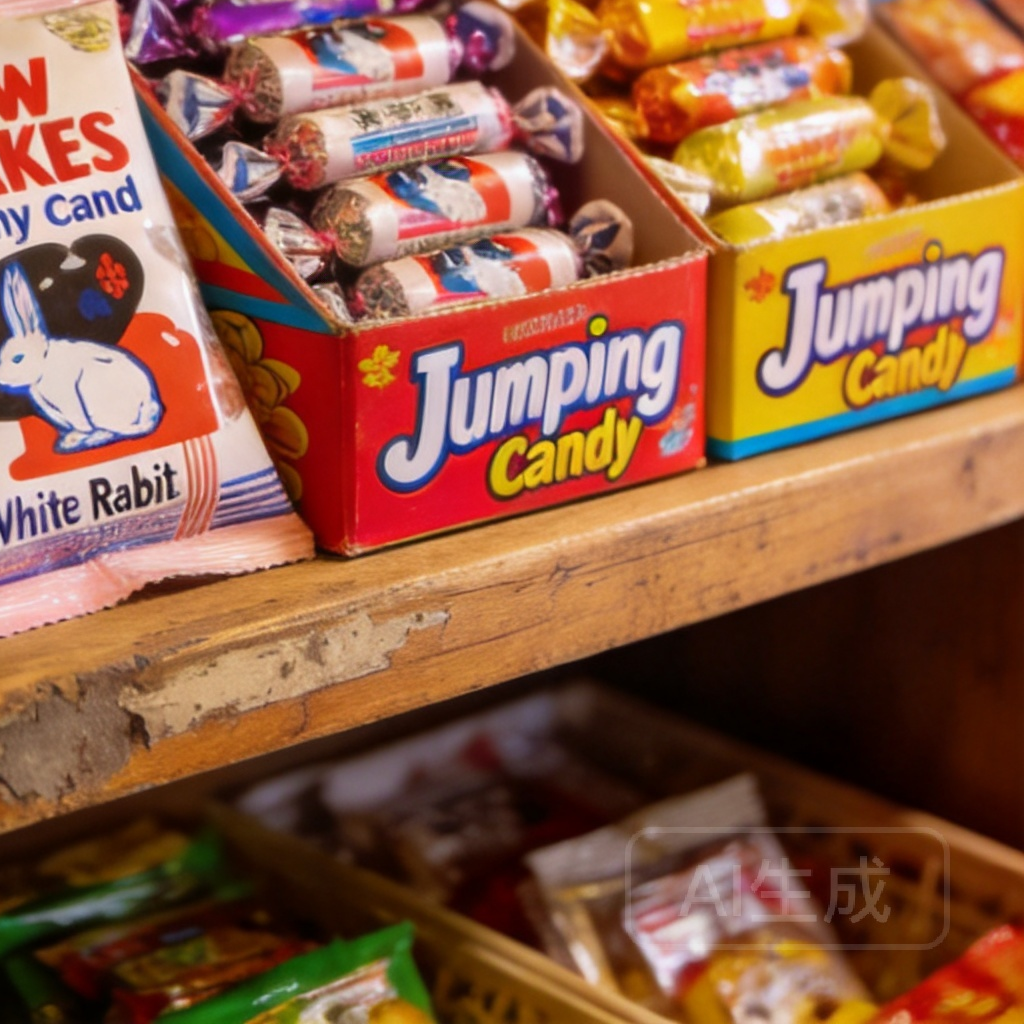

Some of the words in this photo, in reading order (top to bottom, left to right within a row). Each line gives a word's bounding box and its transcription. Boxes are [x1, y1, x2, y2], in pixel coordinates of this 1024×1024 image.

[44, 175, 142, 227] Cand
[759, 240, 1004, 396] Jumping
[379, 315, 684, 490] Jumping
[843, 325, 968, 410] Candy
[89, 462, 180, 521] Rabit
[488, 406, 643, 500] Candy
